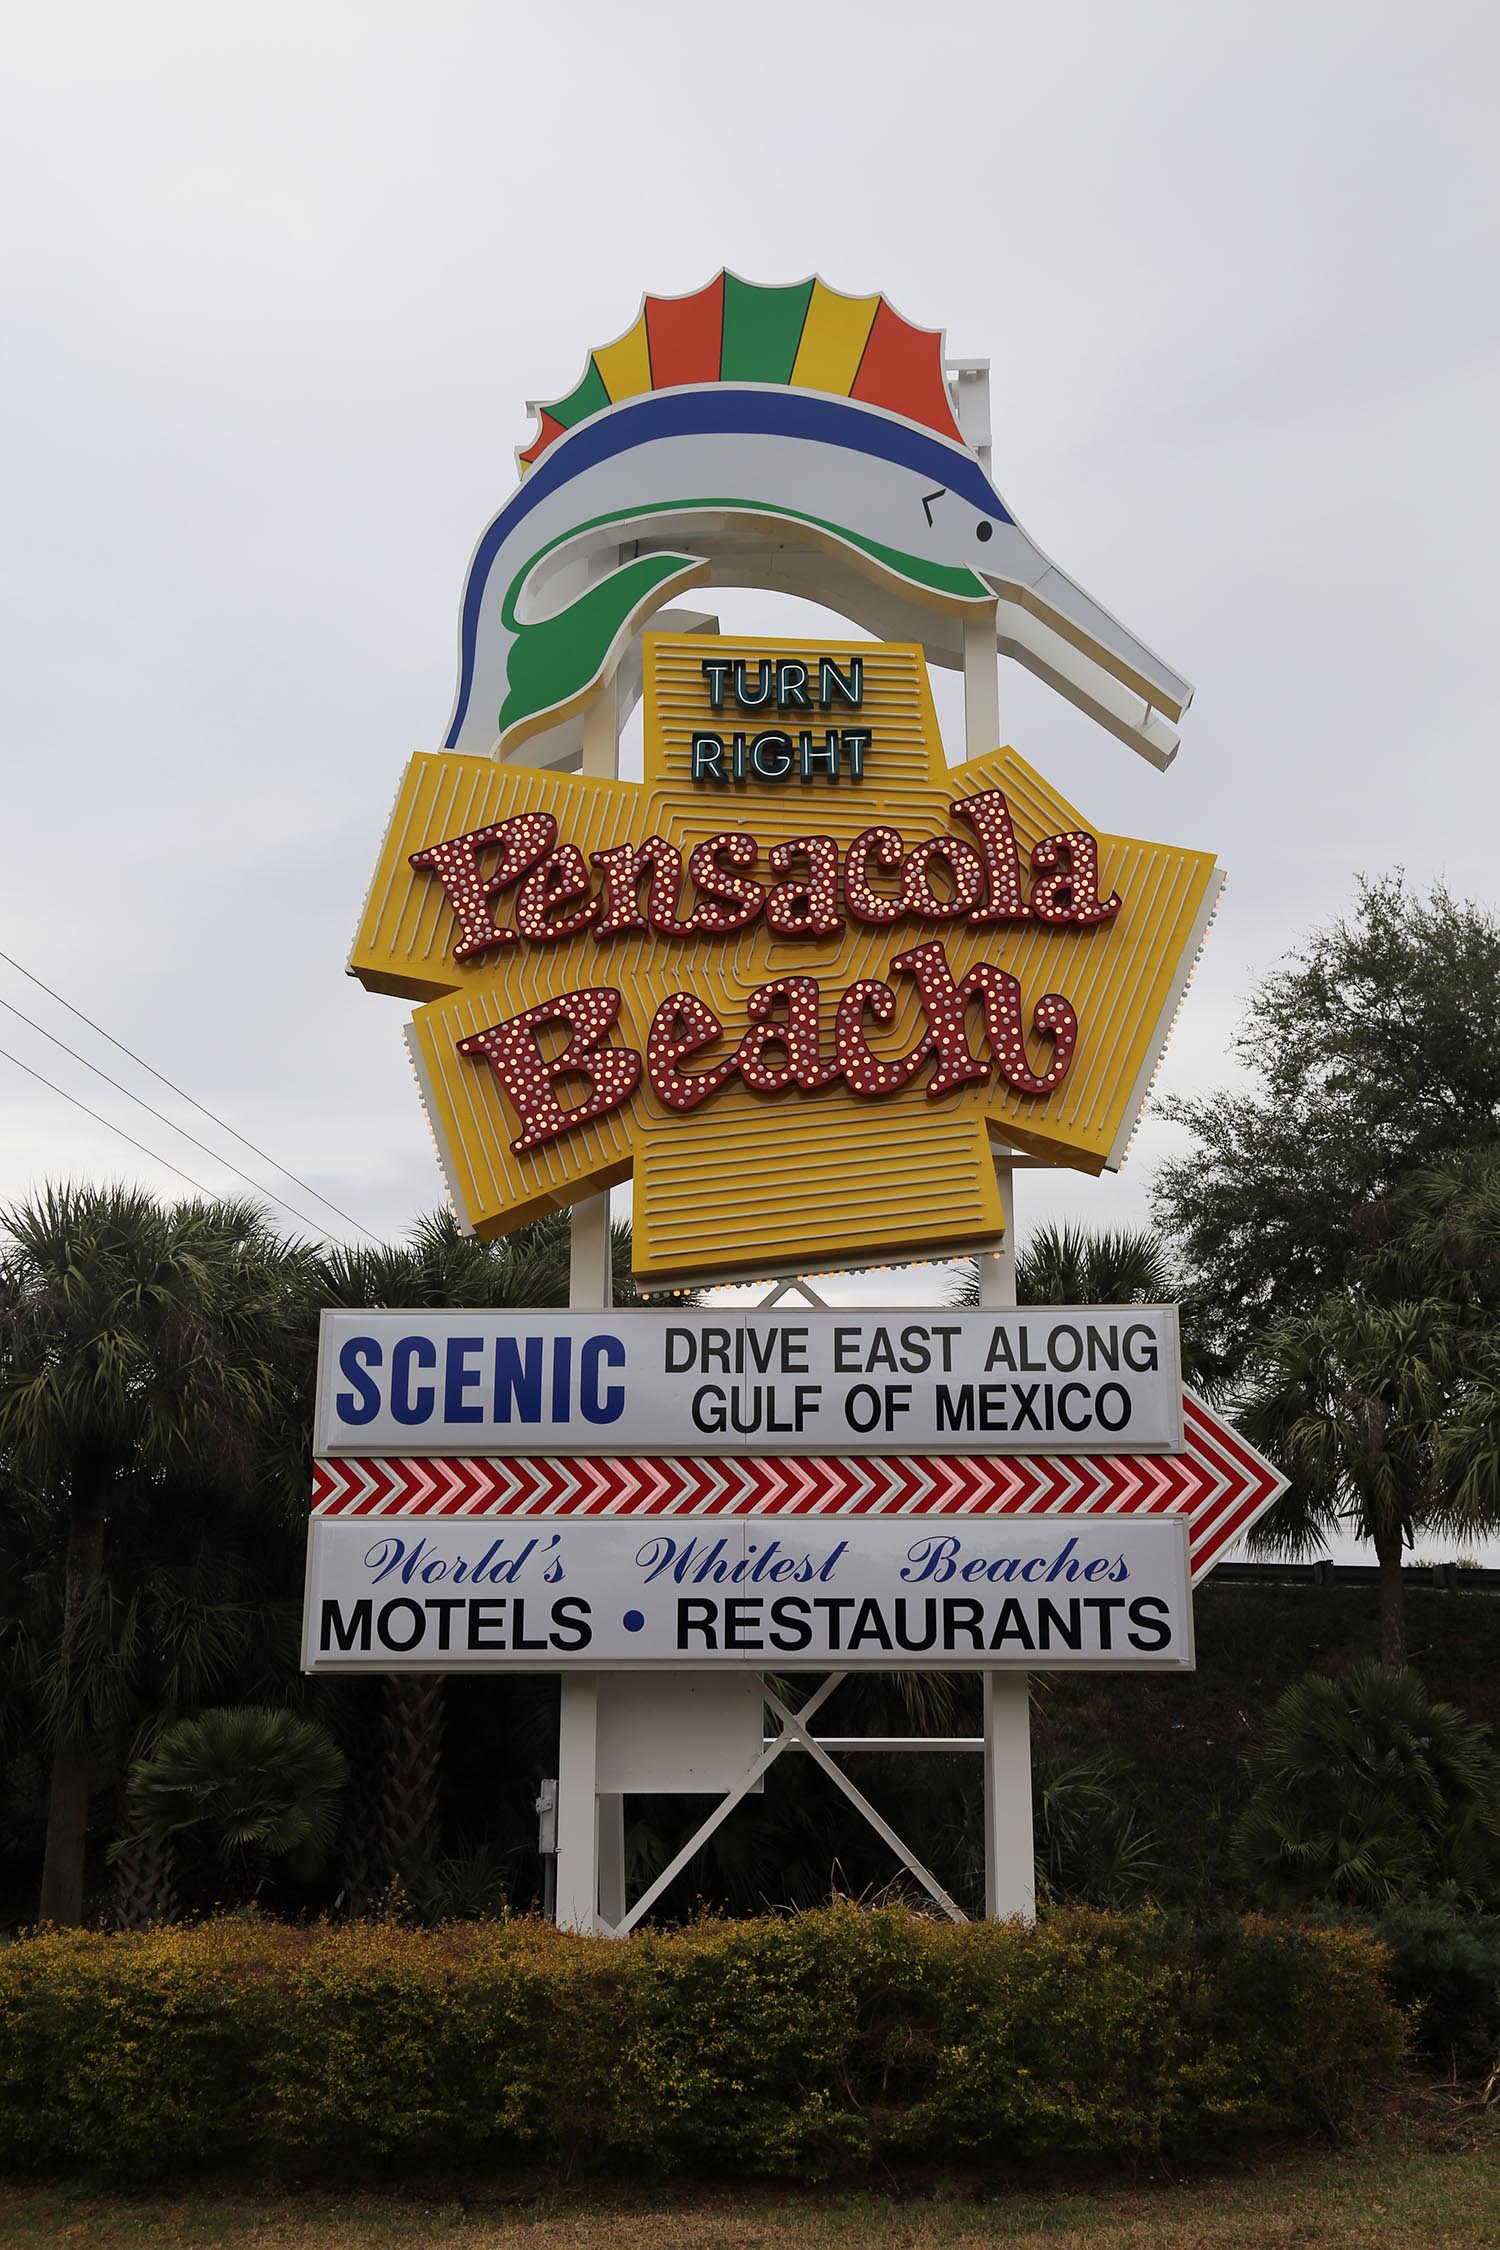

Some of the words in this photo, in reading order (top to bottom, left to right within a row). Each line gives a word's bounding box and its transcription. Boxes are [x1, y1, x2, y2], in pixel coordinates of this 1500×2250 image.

[701, 656, 864, 710] TURN
[691, 728, 872, 784] RIGHT
[408, 789, 1122, 964] Pensacola
[456, 940, 1078, 1156] Beach
[664, 1327, 809, 1375] DRIVE
[833, 1325, 962, 1374] EAST
[984, 1323, 1158, 1373] ALONG
[336, 1335, 626, 1425] SCENIC
[692, 1384, 822, 1434] GULF
[844, 1383, 912, 1433] OF
[936, 1382, 1132, 1432] MEXICO
[364, 1534, 566, 1585] World's
[635, 1535, 849, 1584] Whitest
[900, 1535, 1131, 1583] Beaches
[319, 1597, 593, 1652] MOTELS
[676, 1596, 1172, 1653] RESTAURANTS
